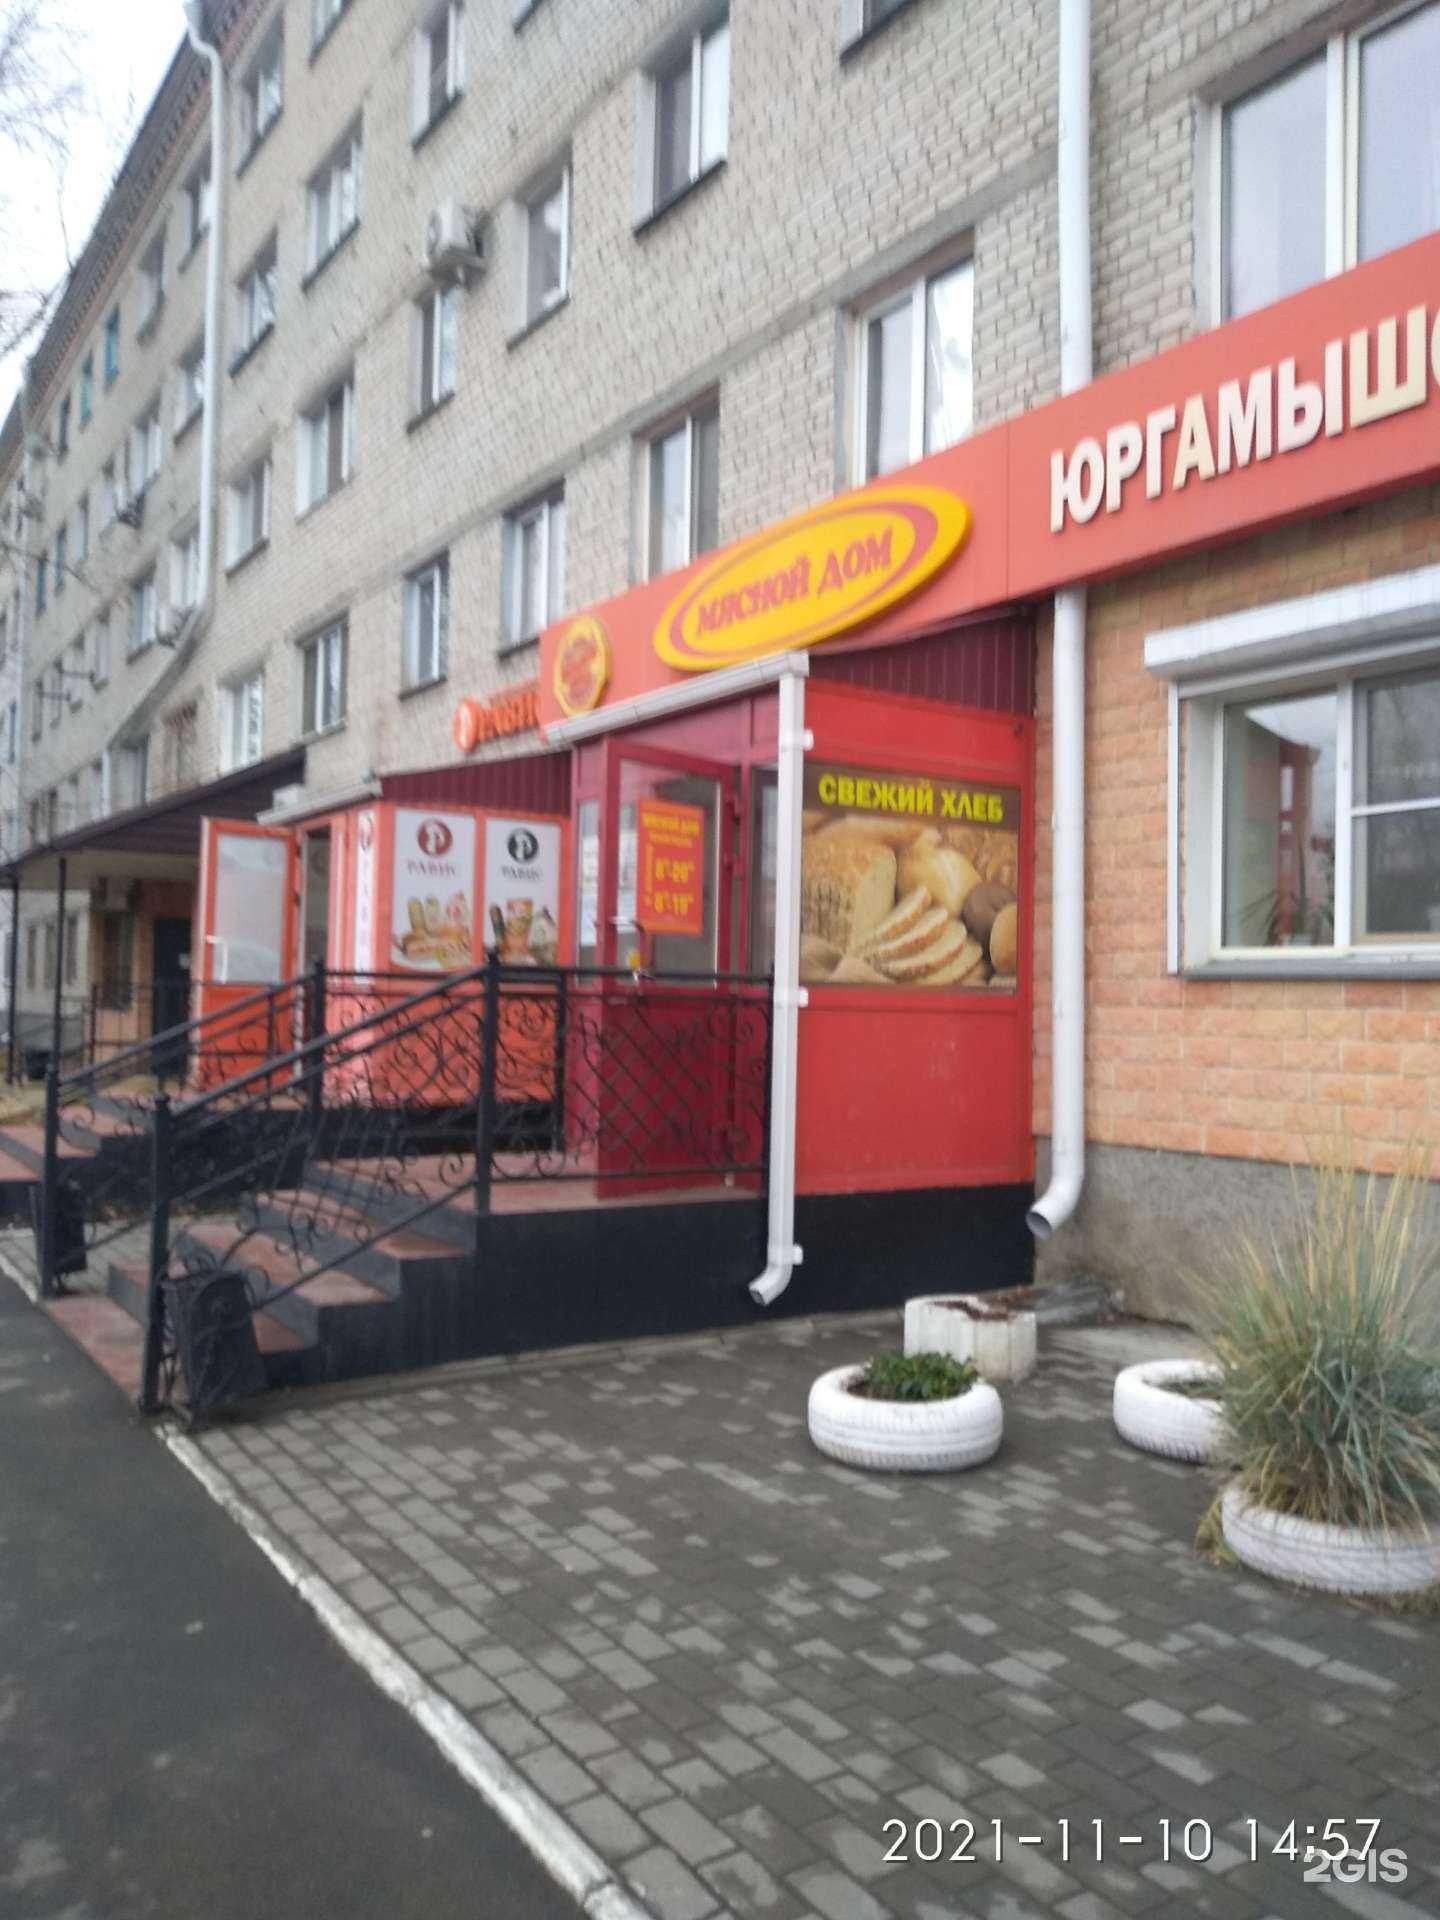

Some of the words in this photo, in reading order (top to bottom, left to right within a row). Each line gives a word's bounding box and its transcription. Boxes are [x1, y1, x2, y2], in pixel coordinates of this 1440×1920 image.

[1050, 304, 1440, 534] ЮРГАМЫШ
[696, 554, 810, 638] МЯСНОЙ
[818, 525, 894, 600] ДОМ
[818, 773, 934, 817] СВЕЖИЙ
[940, 789, 1004, 823] ХЛЕБ
